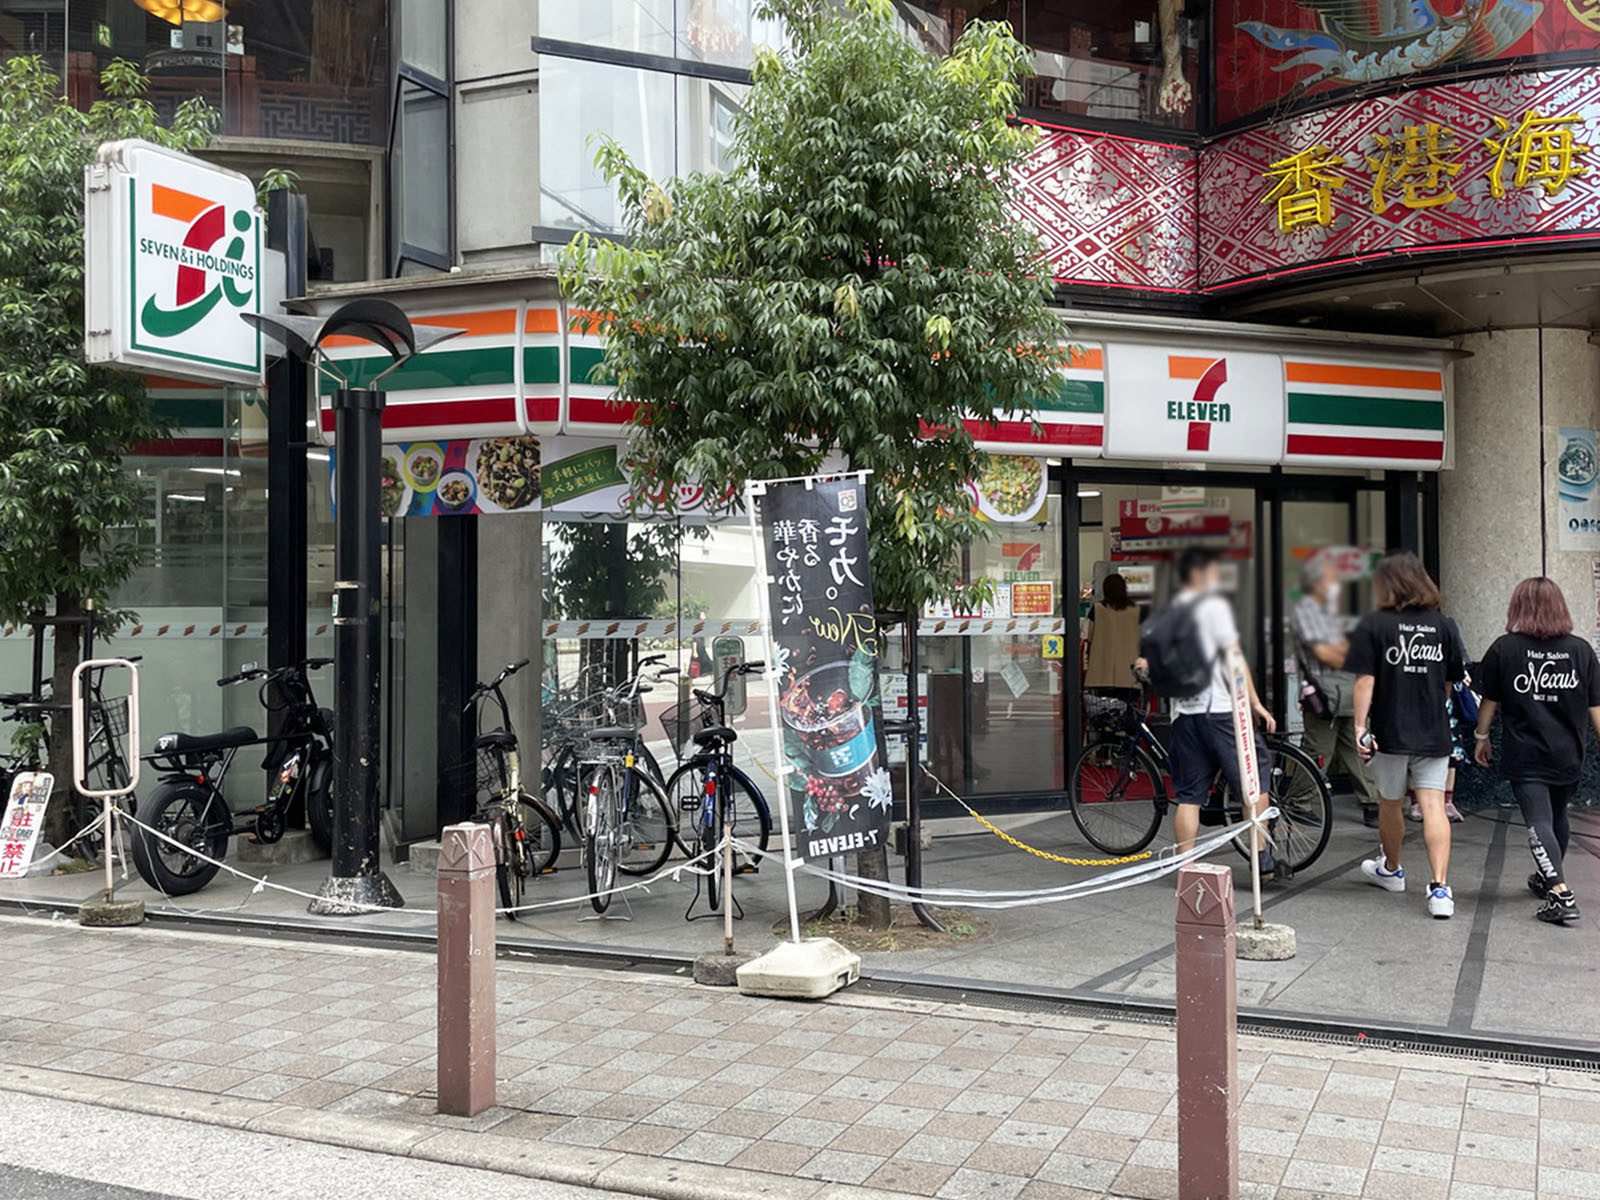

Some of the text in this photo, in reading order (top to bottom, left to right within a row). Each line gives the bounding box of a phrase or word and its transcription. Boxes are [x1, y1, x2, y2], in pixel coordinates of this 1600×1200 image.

[1261, 110, 1590, 233] 香港海
[196, 253, 254, 280] HOLDINGS
[1416, 624, 1436, 633] Salon
[1386, 632, 1444, 665] Nexus
[1527, 649, 1570, 660] Hair Salon
[1513, 660, 1580, 693] Nexus
[1532, 846, 1558, 878] NIKE
